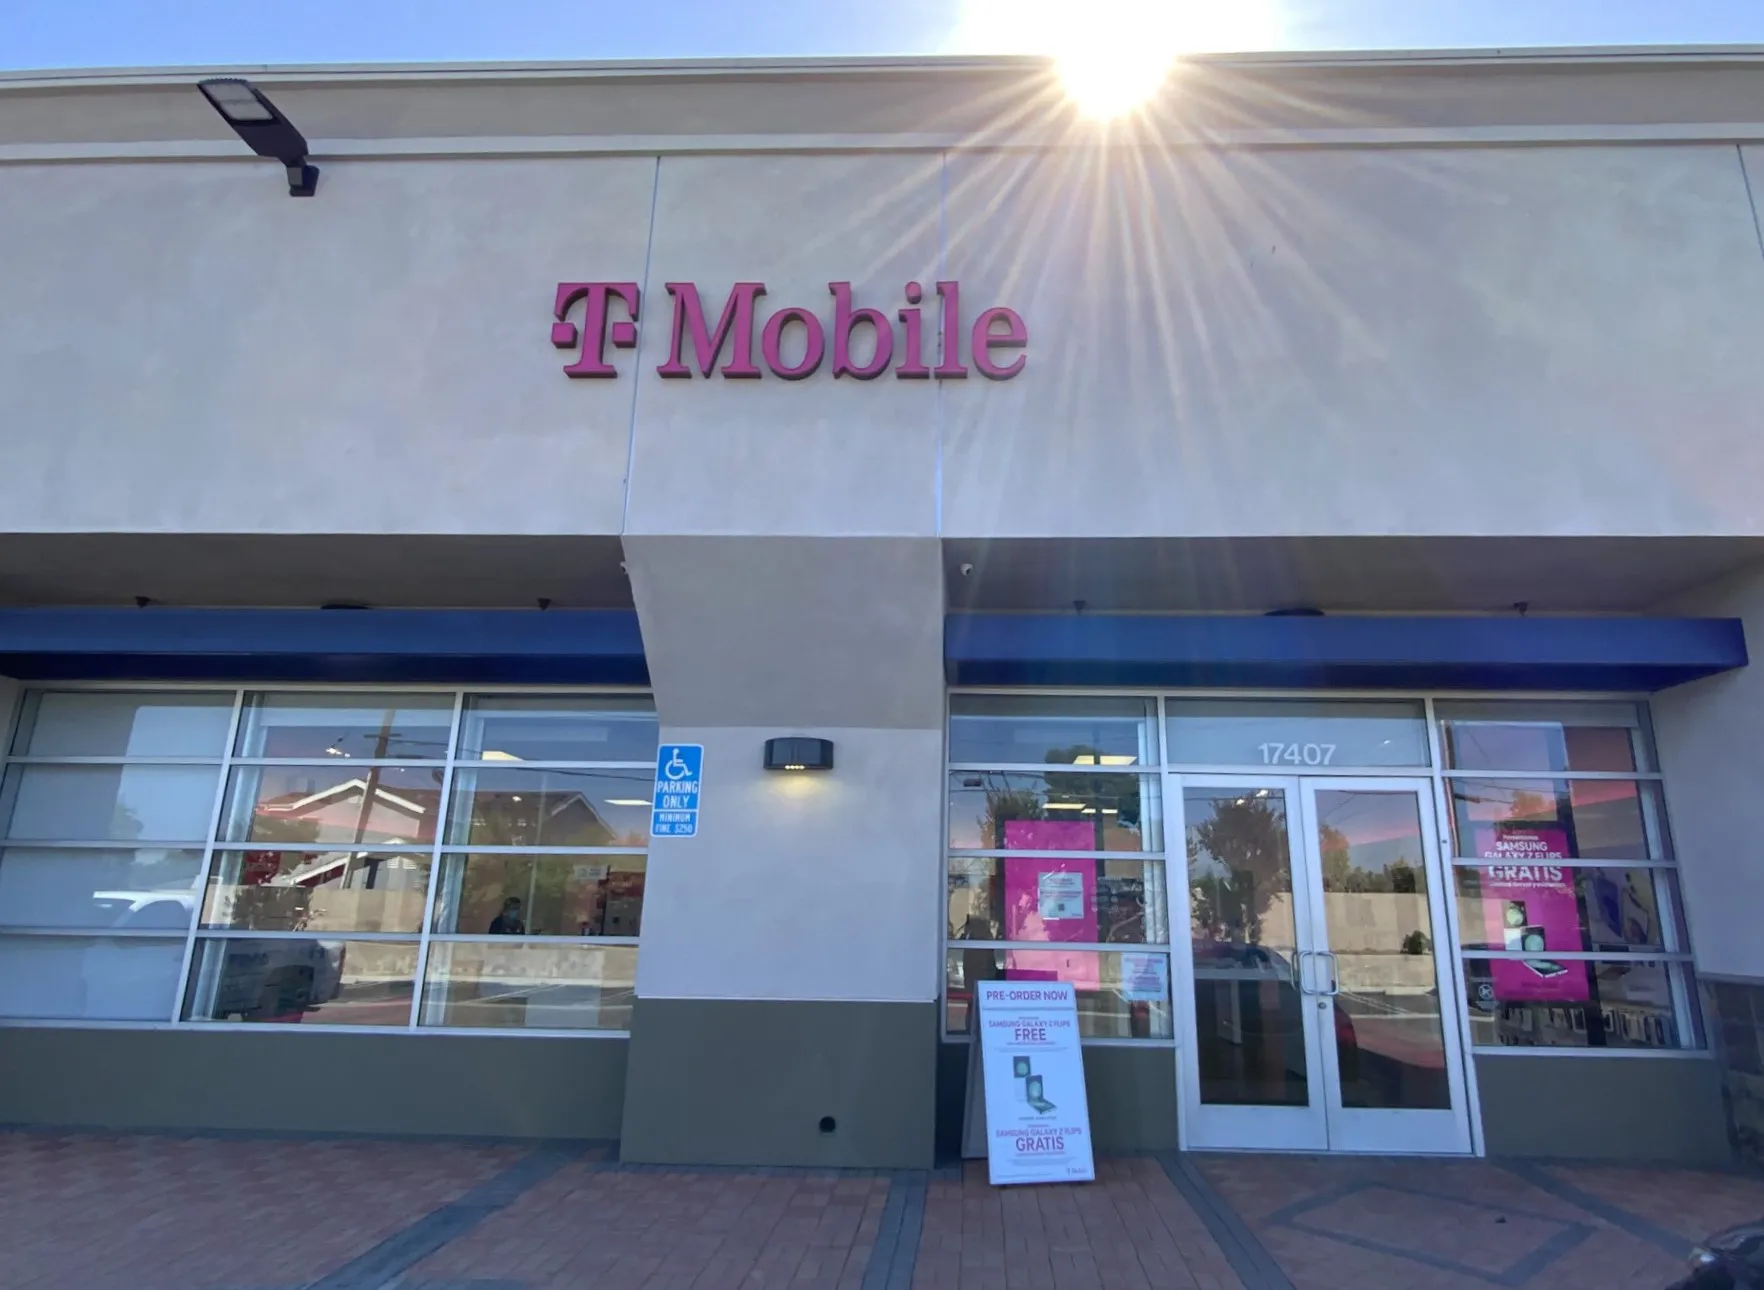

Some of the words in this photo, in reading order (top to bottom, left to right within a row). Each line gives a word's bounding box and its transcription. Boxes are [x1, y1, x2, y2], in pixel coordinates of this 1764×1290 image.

[657, 281, 1028, 381] Mobile
[1258, 743, 1336, 765] 17407
[657, 781, 698, 794] PARKING
[663, 795, 690, 808] ONLY
[659, 813, 690, 823] MINIMUM
[655, 823, 671, 833] FINE
[675, 823, 693, 833] $250
[1495, 841, 1548, 852] SAMSUNG
[1487, 865, 1563, 881] GRATIS
[986, 990, 1041, 1001] PRE-ORDER
[1043, 990, 1068, 1000] NOW
[988, 1020, 1020, 1028] SAMSUNG
[1022, 1020, 1048, 1028] GALAXY
[1014, 1028, 1047, 1041] FREE
[996, 1129, 1029, 1138] SAMSUNG
[1030, 1128, 1058, 1136] GALAXY
[1015, 1136, 1065, 1152] GRATIS
